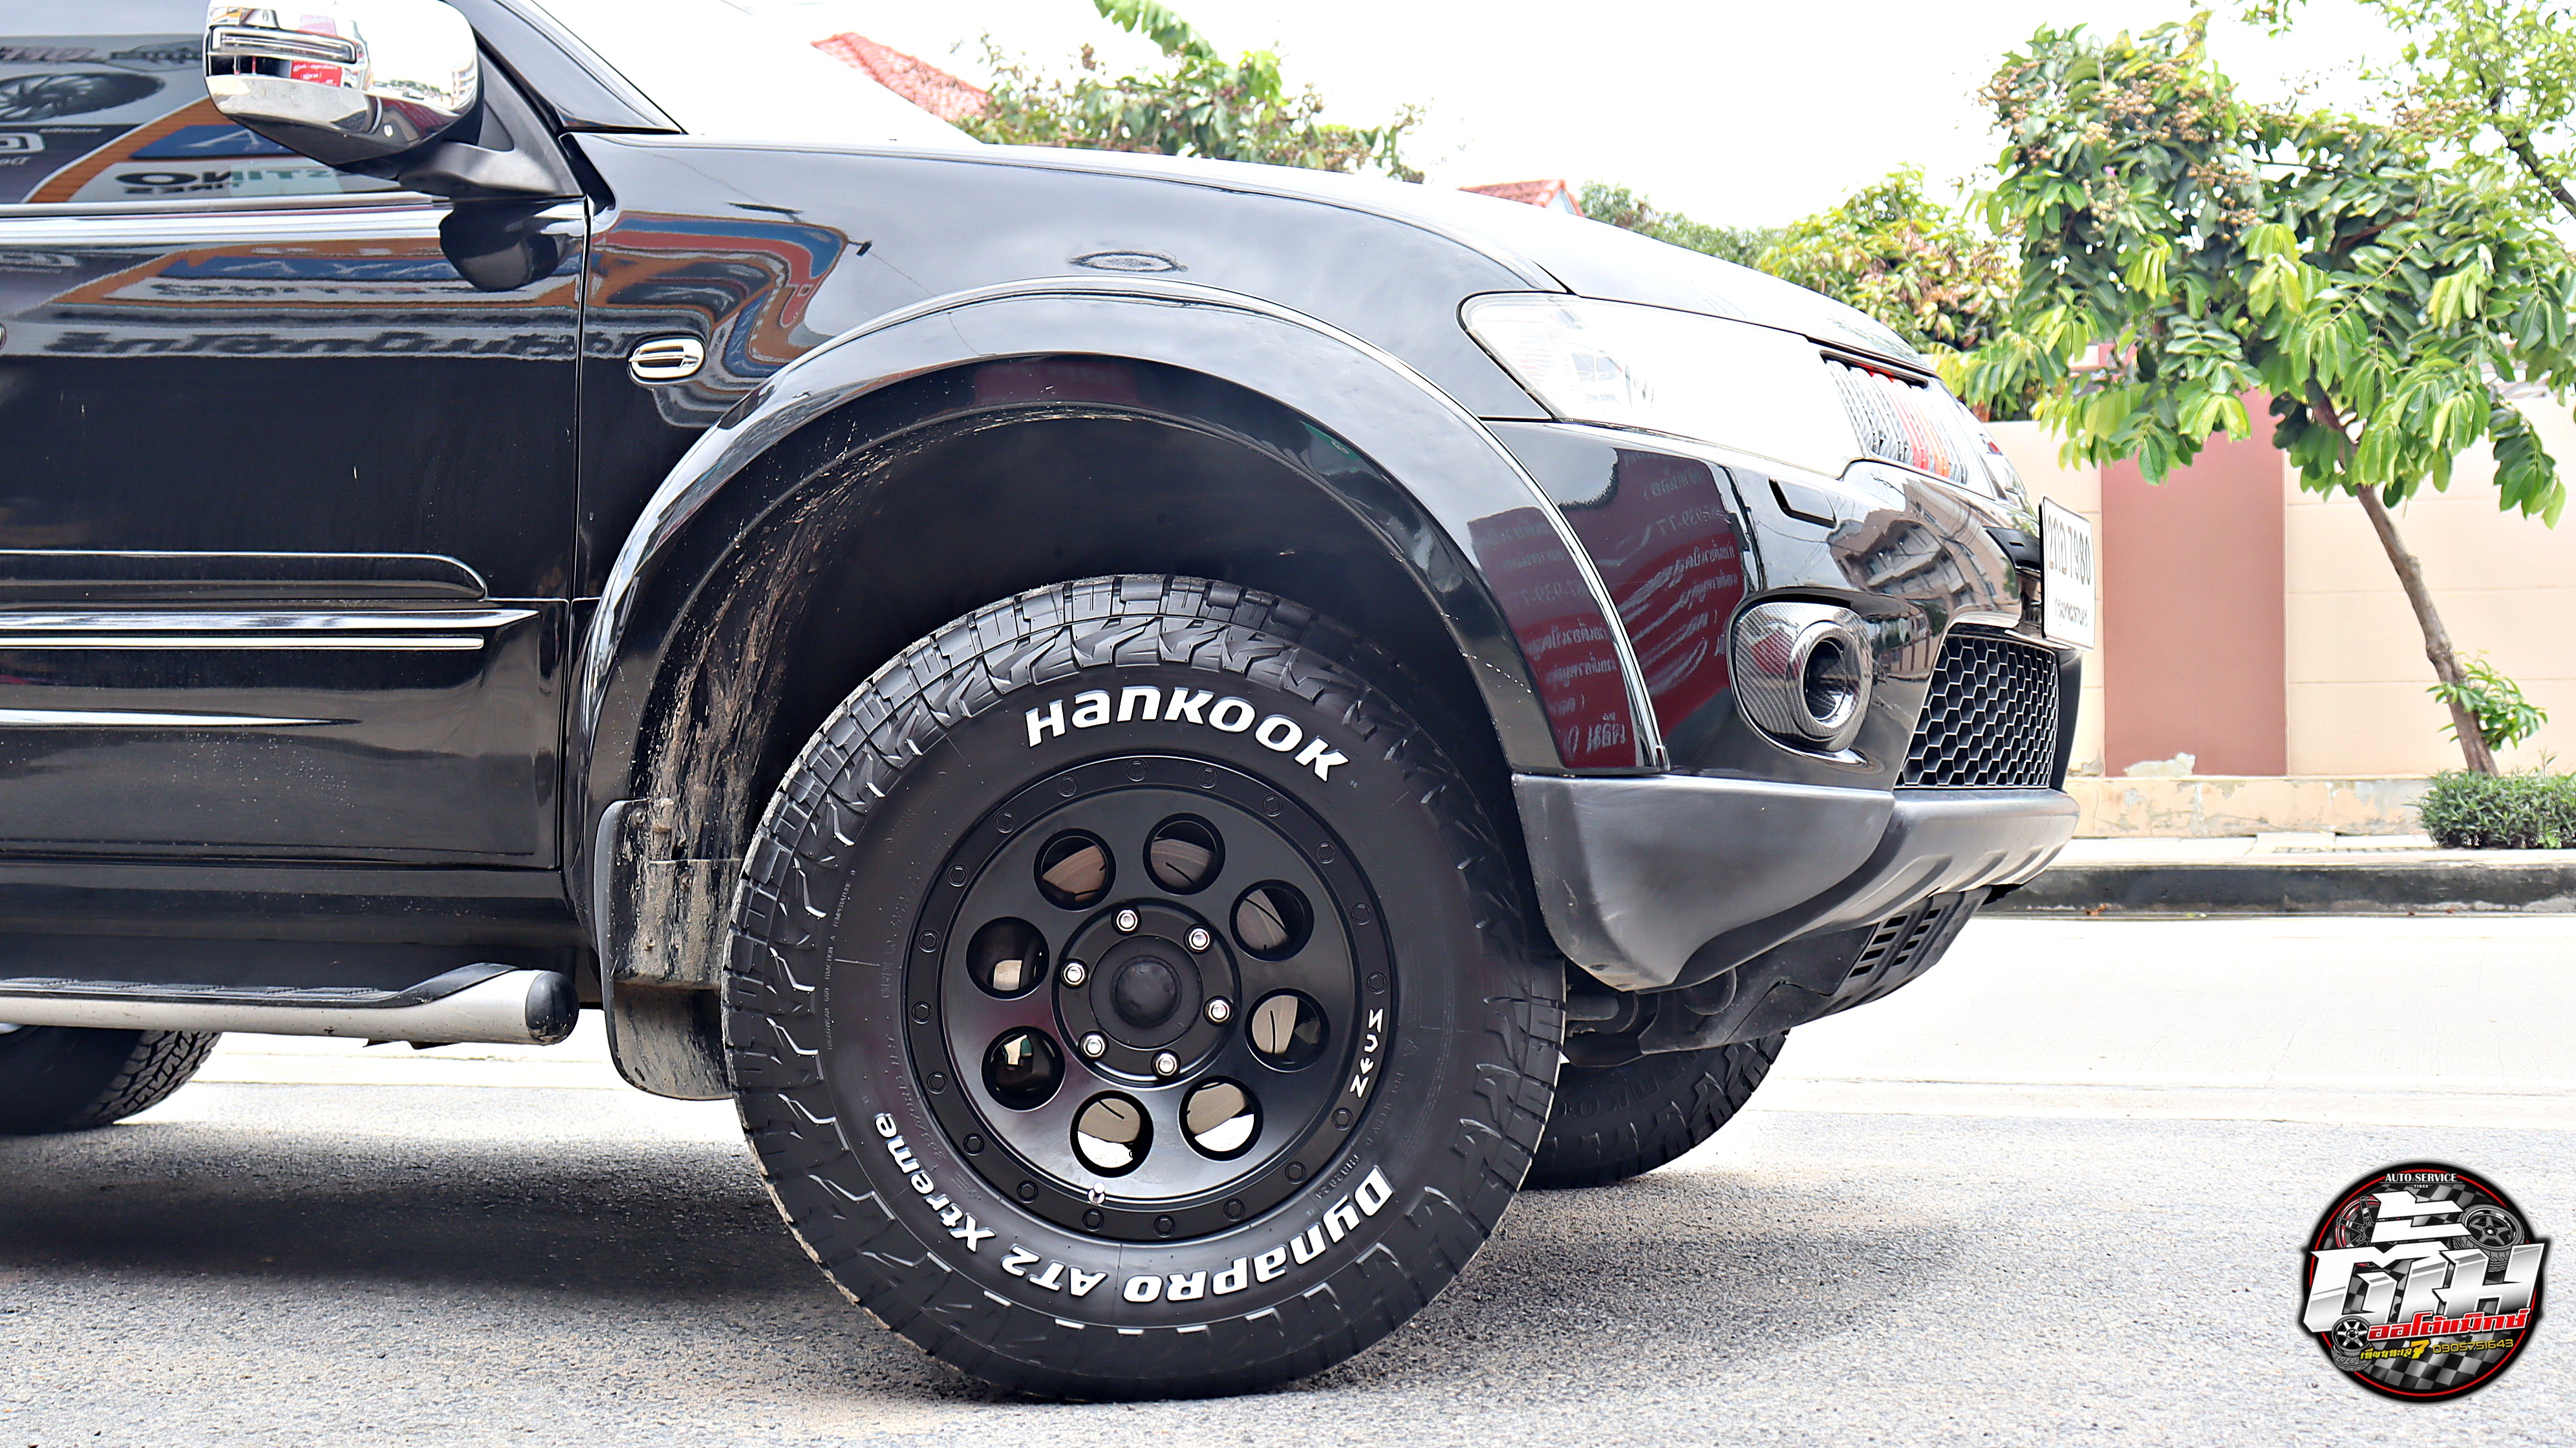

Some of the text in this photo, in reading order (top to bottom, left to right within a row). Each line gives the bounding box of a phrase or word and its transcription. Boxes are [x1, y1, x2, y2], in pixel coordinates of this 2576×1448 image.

[2068, 525, 2091, 586] 7980
[874, 1113, 996, 1253] Xtreme
[1001, 1246, 1108, 1297] AT2
